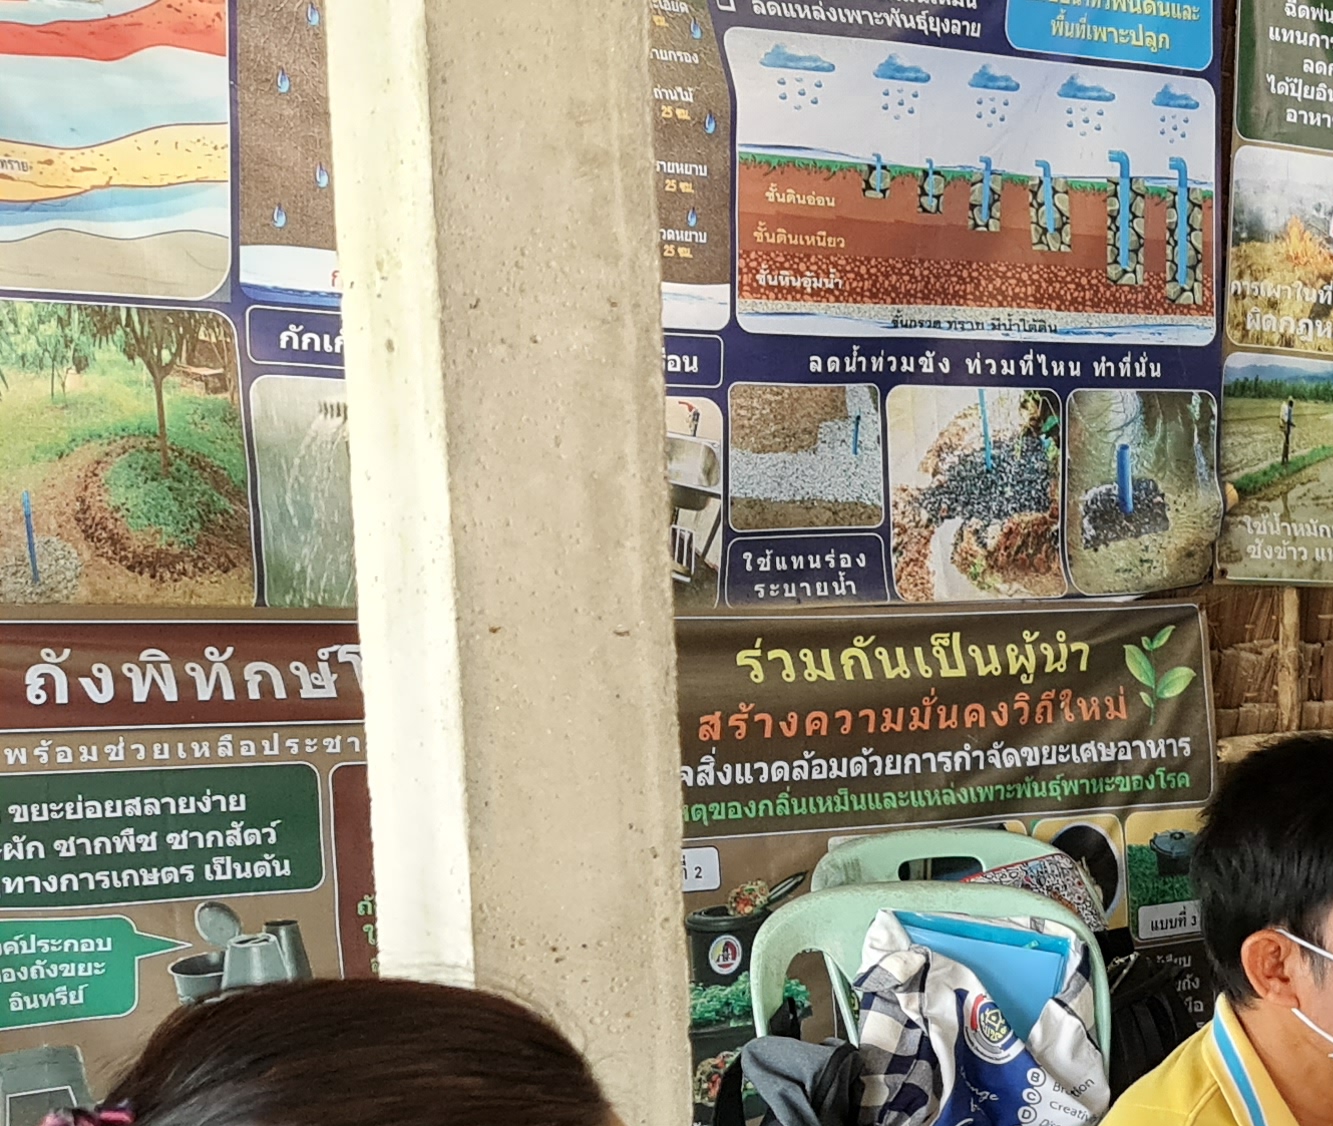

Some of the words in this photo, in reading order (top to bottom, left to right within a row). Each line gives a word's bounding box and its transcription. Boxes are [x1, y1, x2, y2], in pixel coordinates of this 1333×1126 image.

[753, 1, 981, 38] ลดแหล่งเพาะพันธุ์ยุงลาย
[1051, 8, 1170, 52] พื้นที่เพาะปลูก
[765, 183, 836, 207] ชั้นดินอ่อน
[753, 221, 845, 248] ชั้นดินเหนียว
[809, 344, 951, 375] ลดน้ำท่วมขัง
[966, 348, 1081, 379] ท่วมที่ไหน
[1094, 350, 1162, 379] ทำที่นั่น
[742, 548, 867, 571] ใช้แทนร่อง
[753, 570, 858, 599] ระบายน้ำ
[736, 629, 1090, 685] ร่วมกันเป็นผู้นำ
[698, 686, 1128, 742] สร้างความมั่นคงวิถีใหม่
[8, 789, 247, 823] ขยะย่อยสลายง่าย
[53, 827, 157, 858] ซากพืช
[166, 820, 282, 851] ซากสัตว์
[205, 853, 292, 881] เป็นต้น
[1151, 905, 1186, 931] แบบที่
[1191, 915, 1197, 926] 3
[9, 984, 89, 1012] อินทรีย์
